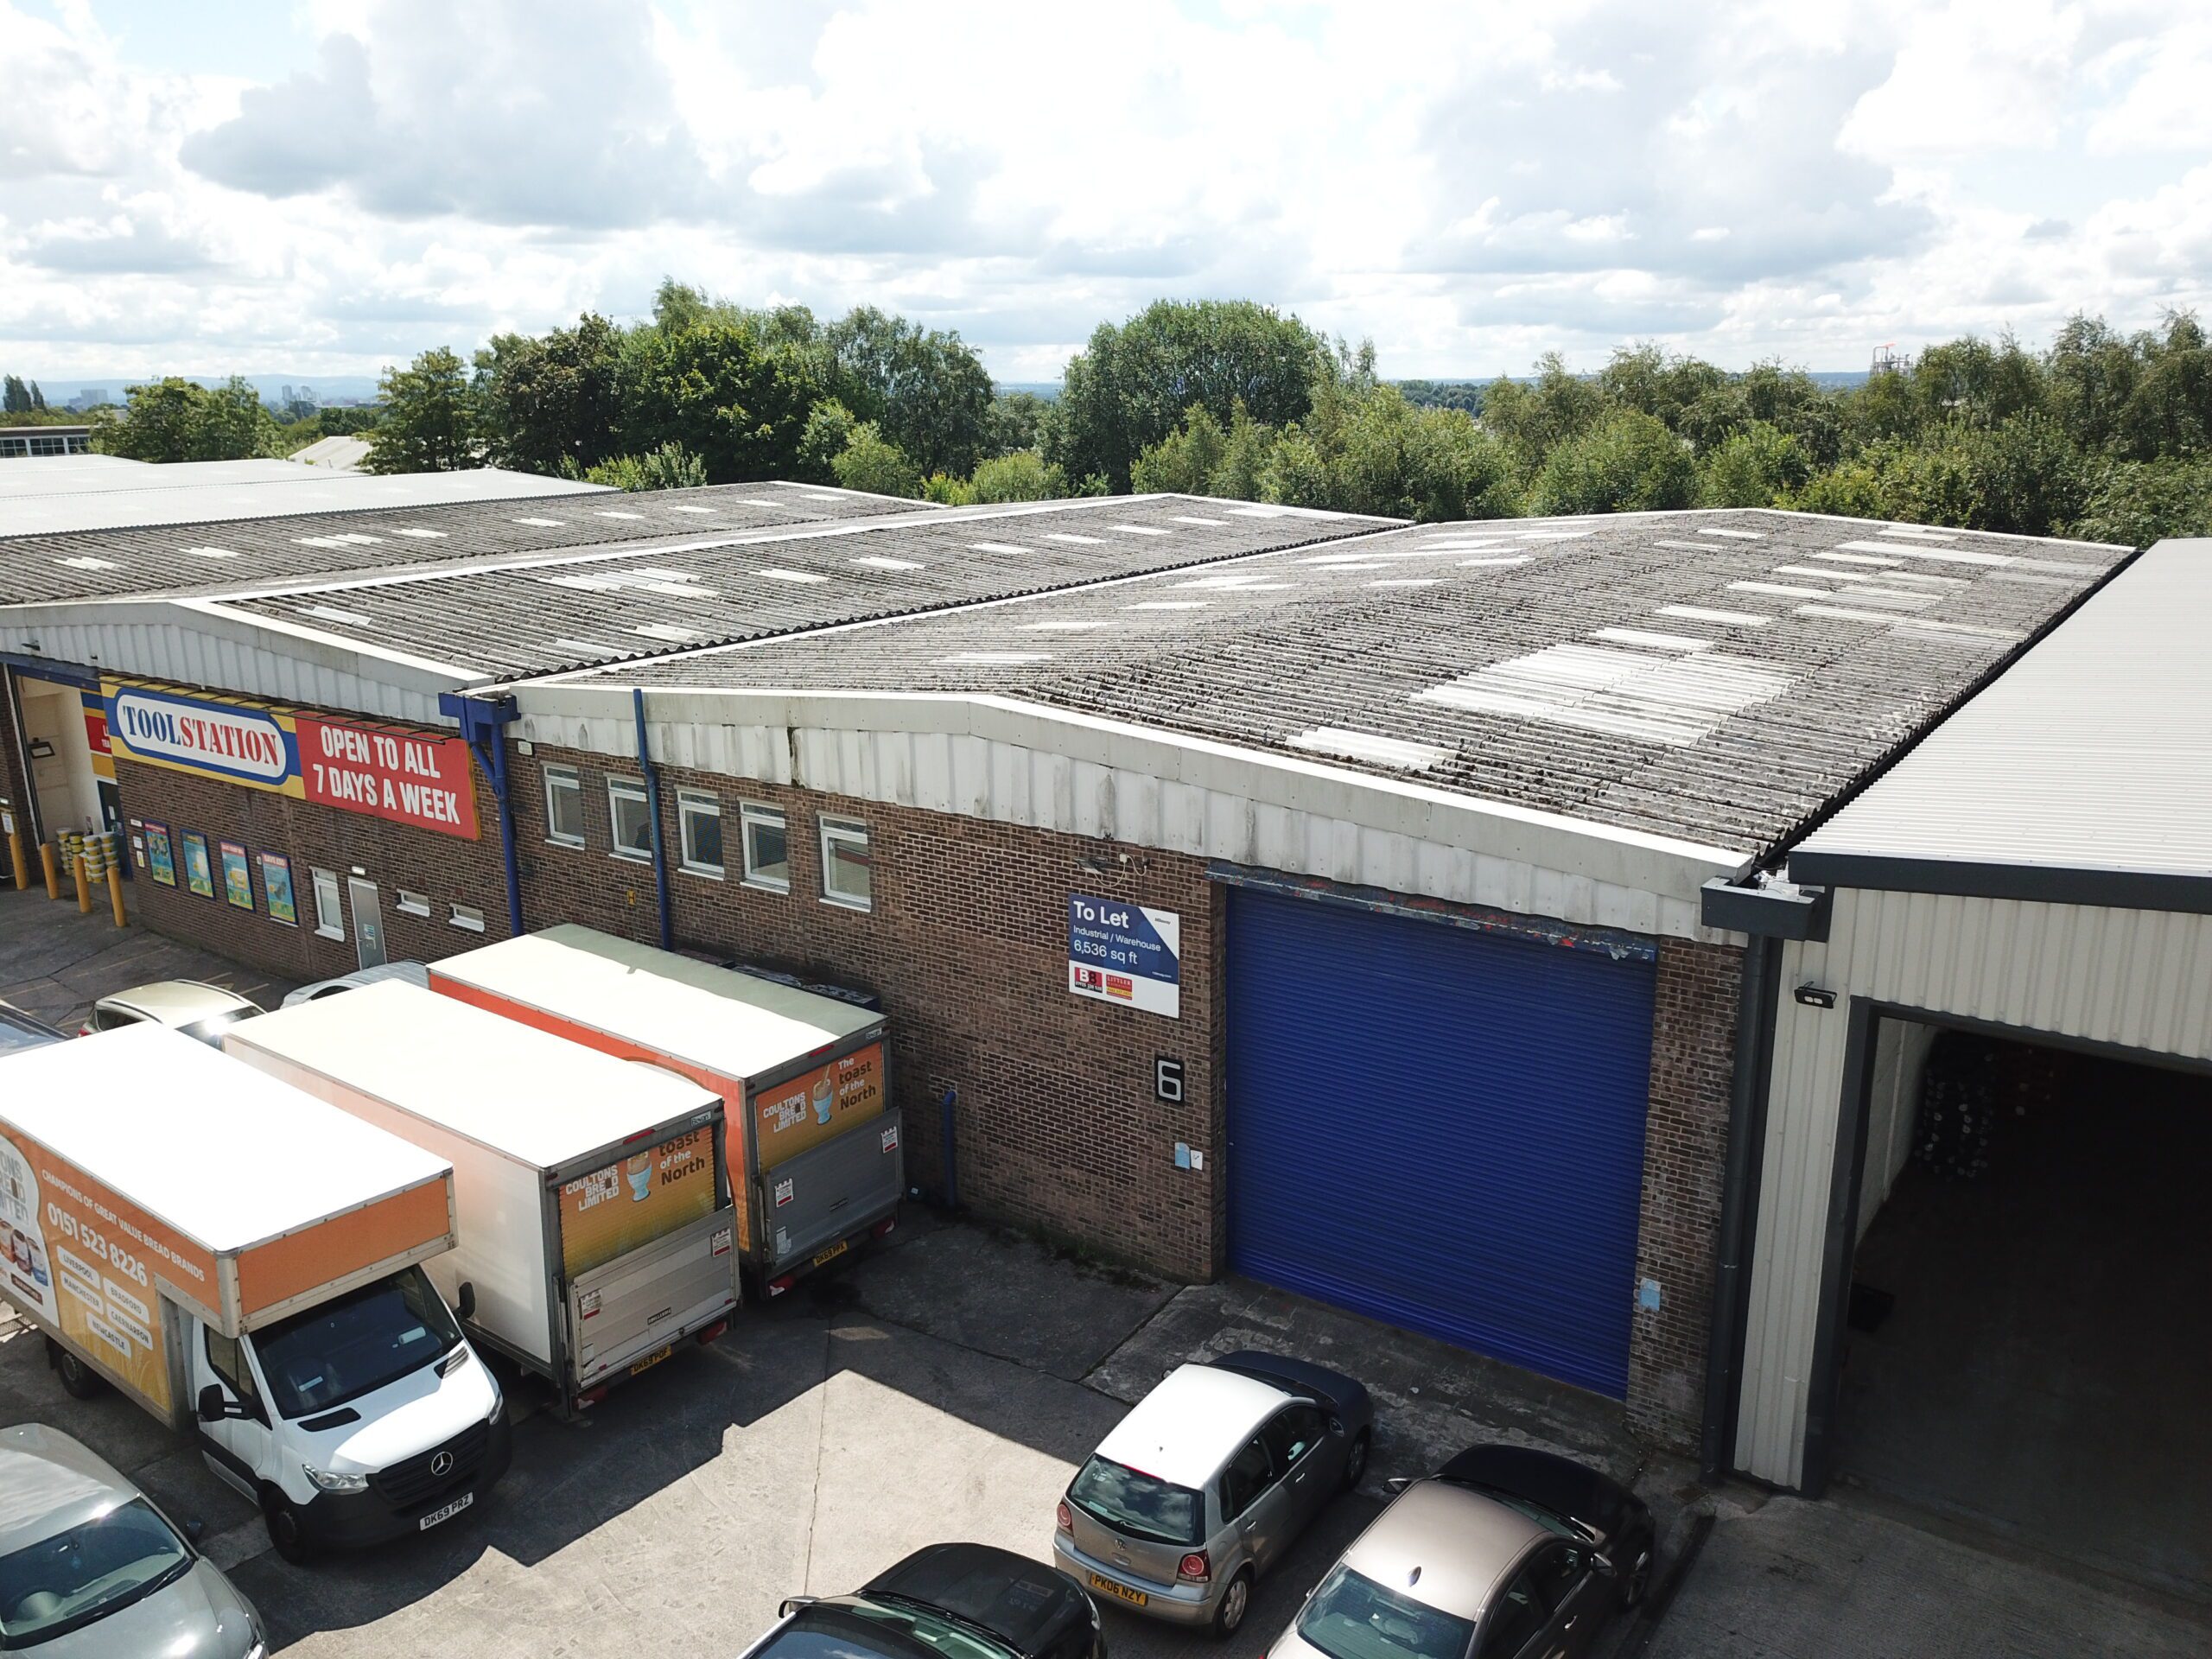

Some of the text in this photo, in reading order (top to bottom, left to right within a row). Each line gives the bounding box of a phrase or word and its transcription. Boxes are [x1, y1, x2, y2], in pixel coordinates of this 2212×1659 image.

[123, 705, 279, 766] TOOLSTATION
[321, 725, 441, 779] OPEN TO ALL
[313, 763, 461, 824] 7 DAYS A WEEK
[1073, 900, 1129, 929] To Let
[1074, 925, 1161, 952] Industrial / Warehouse
[1074, 939, 1138, 964] 6,536 sq ft
[1079, 968, 1096, 985] B8
[1107, 976, 1131, 986] LITTLER
[838, 1058, 855, 1070] The
[839, 1061, 872, 1084] toast
[840, 1079, 865, 1096] of the
[1158, 1059, 1181, 1102] 6
[763, 1092, 806, 1118] COULTONS
[840, 1084, 876, 1110] North
[773, 1110, 807, 1133] LIMITED
[659, 1131, 700, 1157] toast
[660, 1150, 691, 1170] of the
[661, 1157, 705, 1185] North
[565, 1165, 618, 1195] COULTONS
[578, 1185, 620, 1211] LIMITED
[42, 1169, 206, 1282] CHAMPIONS OF GREAT VALUE BREAD BRANDS
[48, 1202, 149, 1287] 0151 523 8226
[63, 1254, 93, 1281] LIVERPOOL
[64, 1276, 100, 1307] MANCHESTER
[111, 1287, 142, 1315] BRADFORD
[92, 1319, 126, 1351] NEWCASTLE
[111, 1311, 149, 1344] CAERNARFON
[424, 1495, 469, 1527] DK69 PRZ
[1095, 1575, 1141, 1602] PK06 NZY
